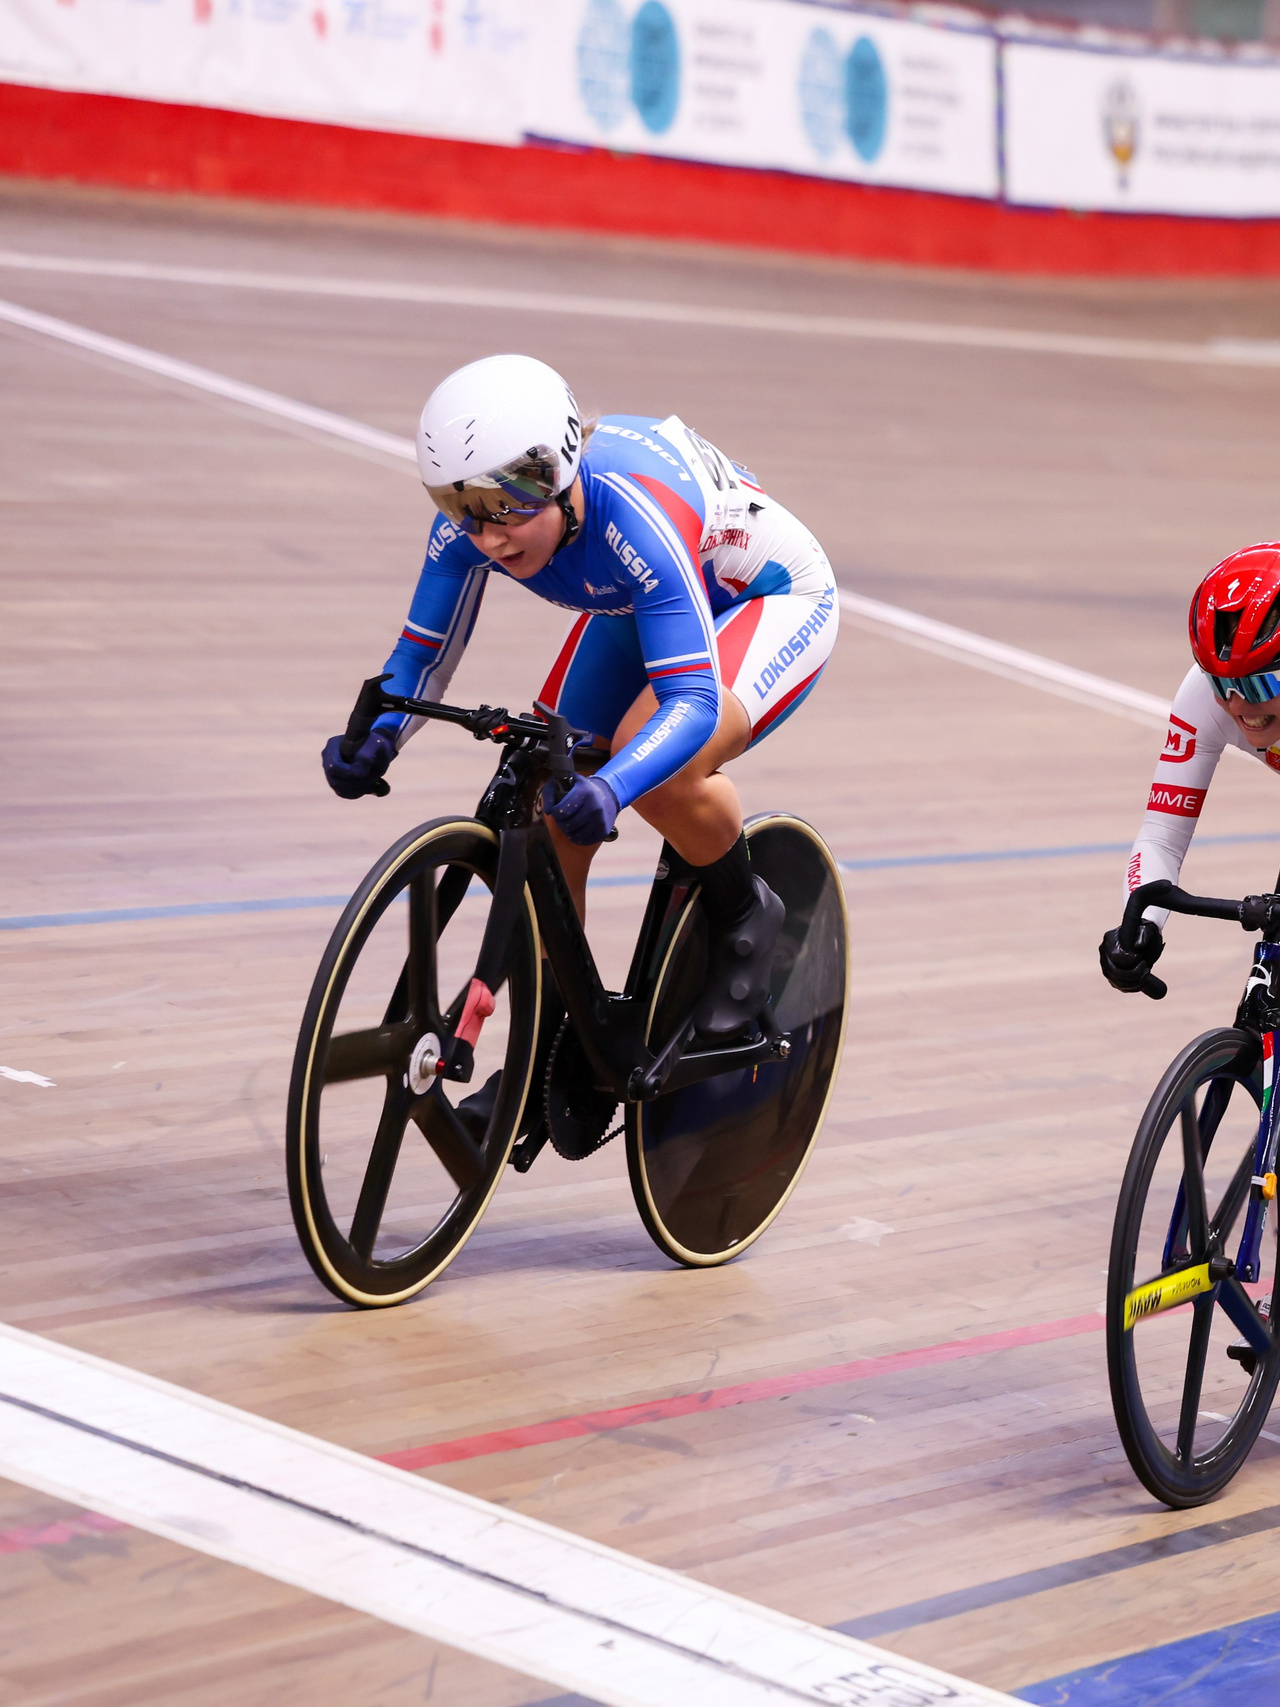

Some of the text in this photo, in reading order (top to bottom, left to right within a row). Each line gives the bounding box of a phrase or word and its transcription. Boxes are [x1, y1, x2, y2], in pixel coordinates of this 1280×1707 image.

[605, 521, 659, 594] RUSSIA
[753, 582, 834, 700] LOKOSPHINX
[631, 700, 691, 762] LOKOSPHINX
